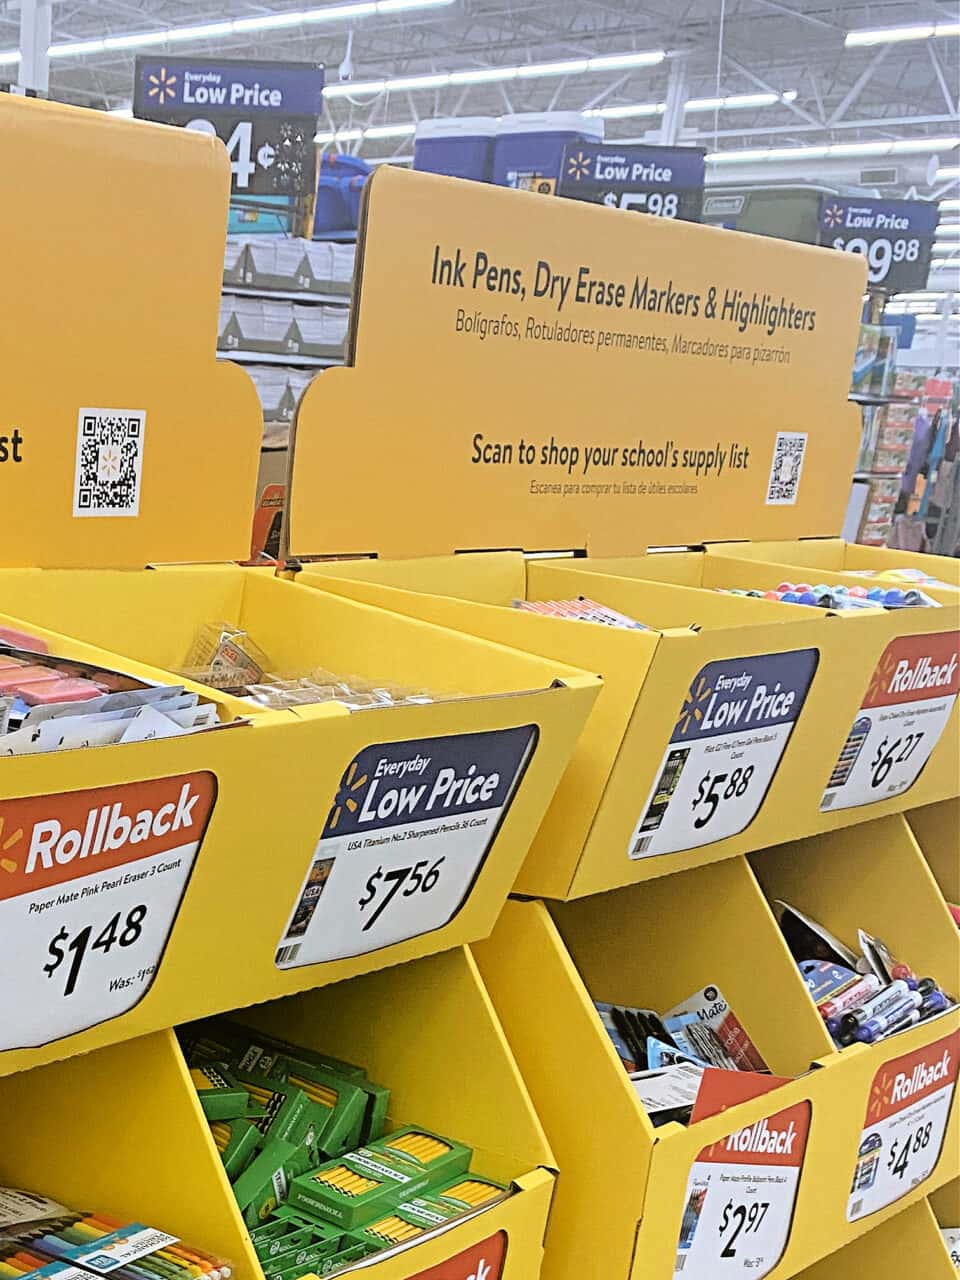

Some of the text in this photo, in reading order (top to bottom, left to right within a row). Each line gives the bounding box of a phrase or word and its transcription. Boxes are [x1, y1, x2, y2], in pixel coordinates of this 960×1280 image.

[184, 72, 221, 83] Everyday
[184, 82, 282, 106] Low Price
[595, 163, 673, 182] Low Price
[846, 213, 909, 229] Low Price
[432, 245, 816, 336] Ink Pens, Dry Erase Markers & Highlighters
[456, 309, 790, 364] Bolígrafos, Rotuladores permanentes, Marcadores para pizarrón
[472, 434, 749, 478] Scan to shop your school's supply list
[715, 672, 752, 691] Everyday
[888, 653, 957, 694] Rollback
[700, 683, 796, 731] Low Price
[375, 754, 432, 778] Everyday
[358, 765, 500, 822] Low Price
[25, 783, 199, 874] Rollback
[347, 817, 488, 851] USA Titanium Sharpened Count
[29, 859, 181, 914] Paper Mate Pink Pearl Eraser Count
[109, 976, 134, 992] Was:
[891, 1049, 951, 1105] Rollback
